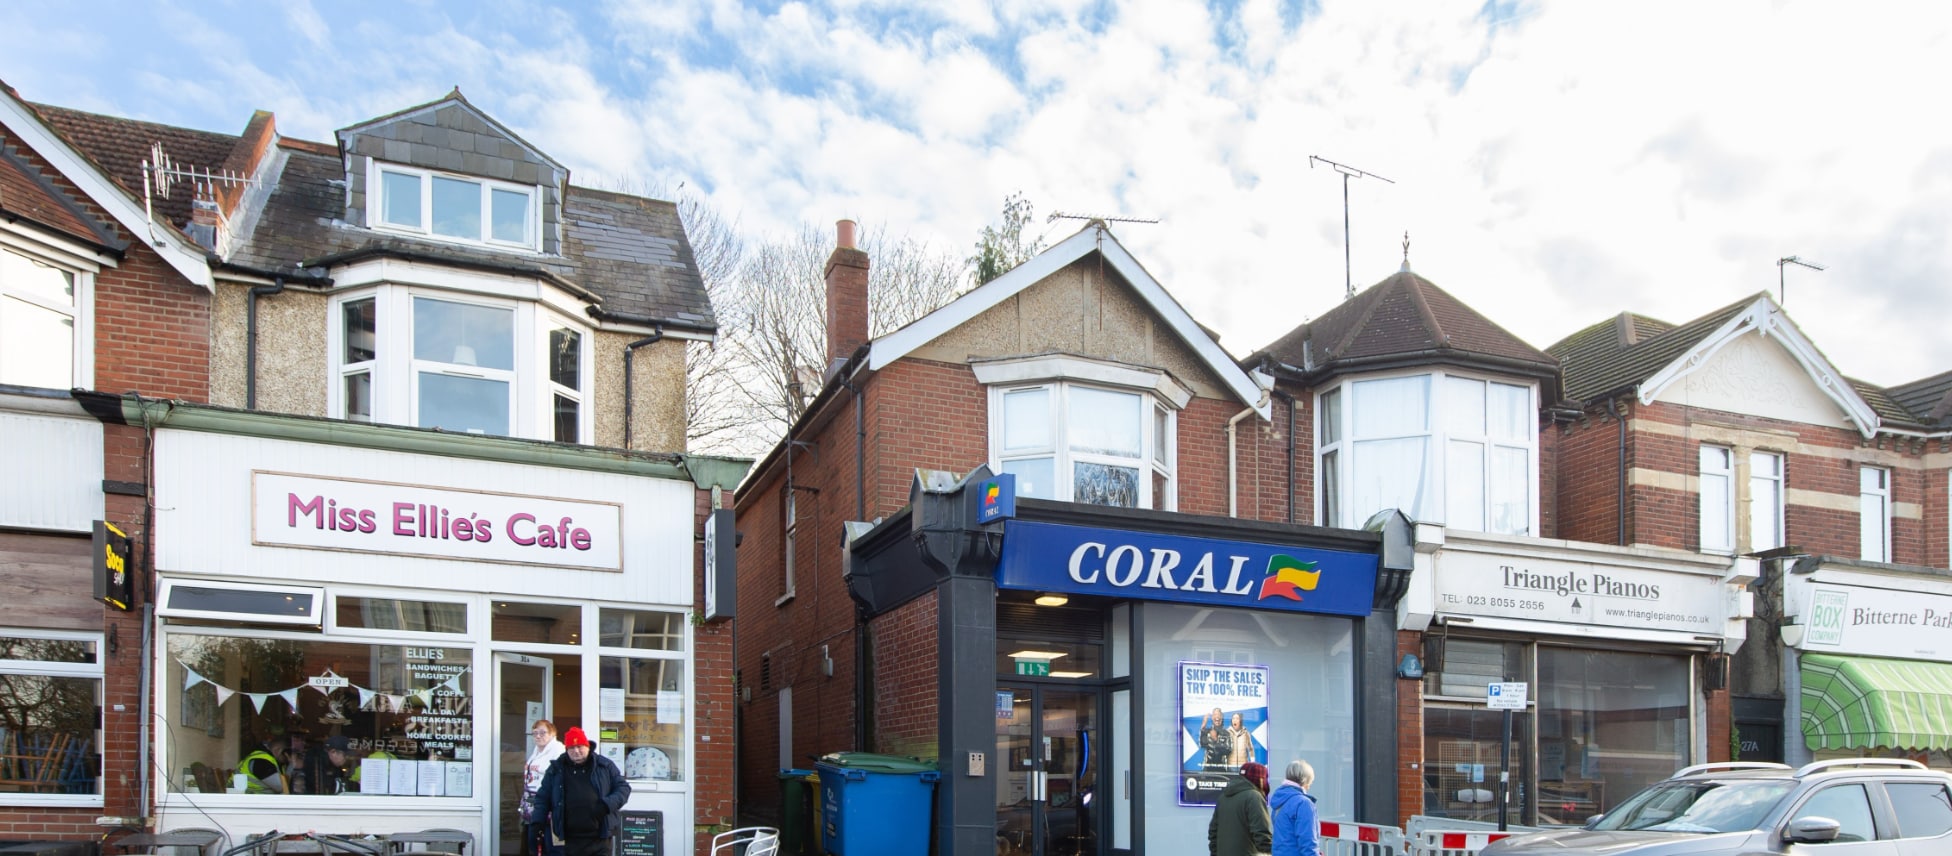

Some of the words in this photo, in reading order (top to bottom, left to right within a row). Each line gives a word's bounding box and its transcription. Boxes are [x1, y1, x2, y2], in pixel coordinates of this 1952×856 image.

[287, 492, 377, 534] Miss
[392, 501, 492, 544] Ellie's
[506, 512, 592, 551] Cafe
[1068, 541, 1254, 596] CORAL
[1500, 565, 1588, 598] Triangle
[1593, 573, 1660, 599] Pianos
[1466, 595, 1487, 606] 023
[1490, 597, 1516, 608] 8055
[1519, 599, 1545, 611] 2656
[1816, 593, 1846, 606] BITTERNE
[1605, 607, 1710, 625] www.trianglepianos.co.uk
[1812, 605, 1843, 629] BOX
[1852, 607, 1918, 626] Bitterne
[1810, 630, 1840, 642] COMPANY
[406, 663, 464, 673] SANDWICHES
[315, 678, 342, 686] OPEN
[1186, 668, 1210, 681] SKIP
[1213, 670, 1231, 683] THE
[1233, 671, 1265, 685] SALES.
[1186, 682, 1206, 695] TRY
[1208, 683, 1235, 696] 100%
[1237, 685, 1262, 698] FREE.
[1492, 686, 1499, 696] P
[422, 707, 439, 715] ALL
[410, 715, 468, 725] BREAKFASTS
[406, 731, 433, 741] HOME
[435, 733, 472, 741] COOKED
[424, 741, 454, 749] MEALS
[1741, 740, 1760, 752] 27A
